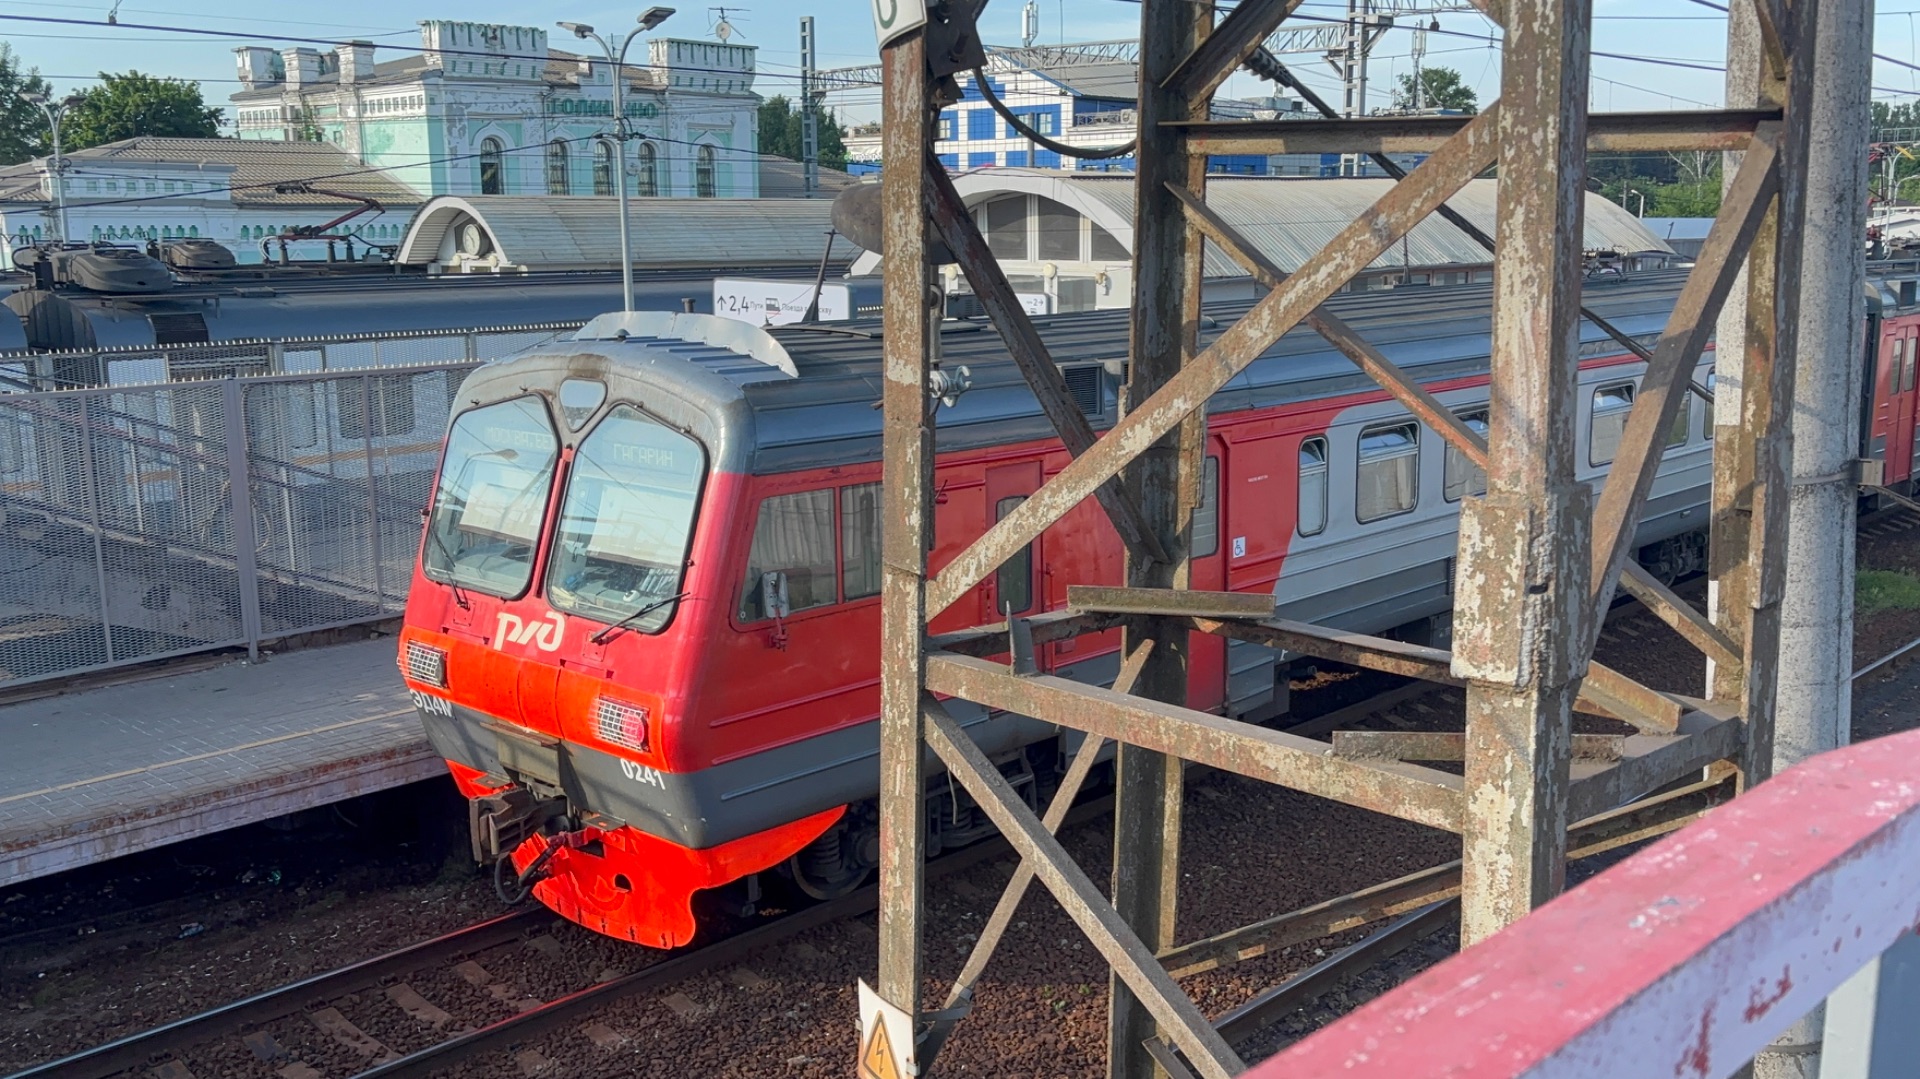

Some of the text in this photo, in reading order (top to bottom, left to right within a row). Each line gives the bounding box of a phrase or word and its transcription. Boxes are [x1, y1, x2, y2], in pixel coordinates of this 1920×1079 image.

[729, 295, 749, 315] 2,4
[613, 443, 673, 467] ГАГАРИН
[410, 688, 453, 718] ЭД4М
[620, 757, 666, 790] 0241
